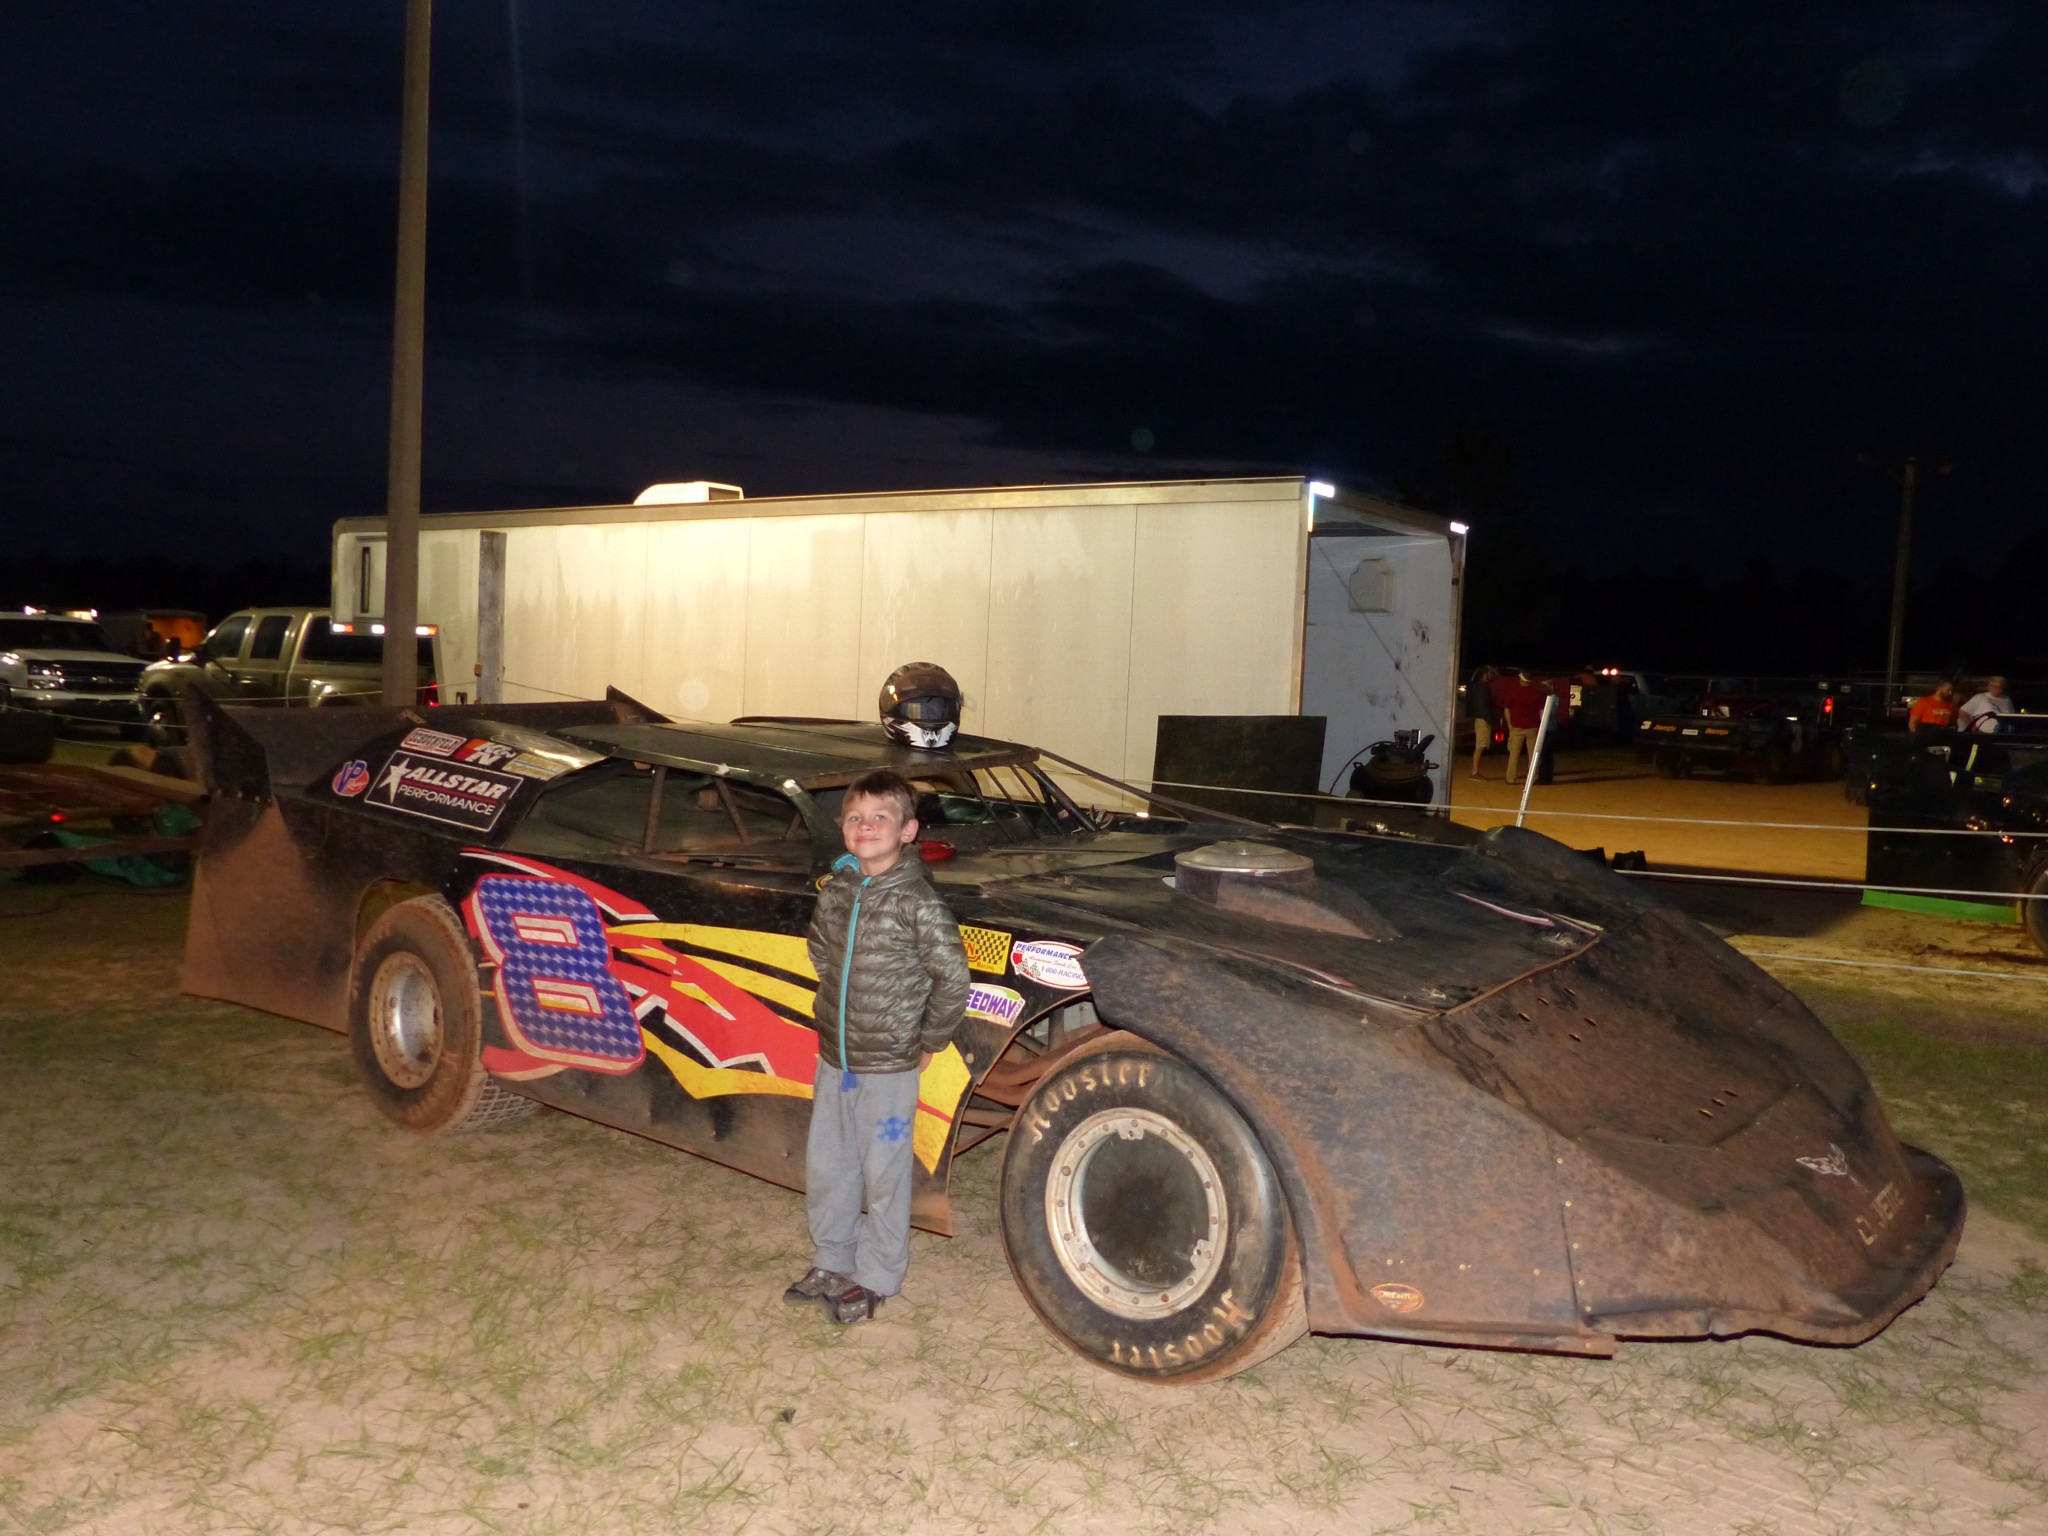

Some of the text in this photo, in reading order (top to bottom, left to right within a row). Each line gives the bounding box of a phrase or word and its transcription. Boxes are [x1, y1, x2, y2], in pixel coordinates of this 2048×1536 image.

[404, 766, 509, 800] ALLSTAR
[399, 784, 496, 817] PERFORMANCE
[1015, 943, 1073, 961] PERFORMANCE
[472, 873, 646, 1072] 8
